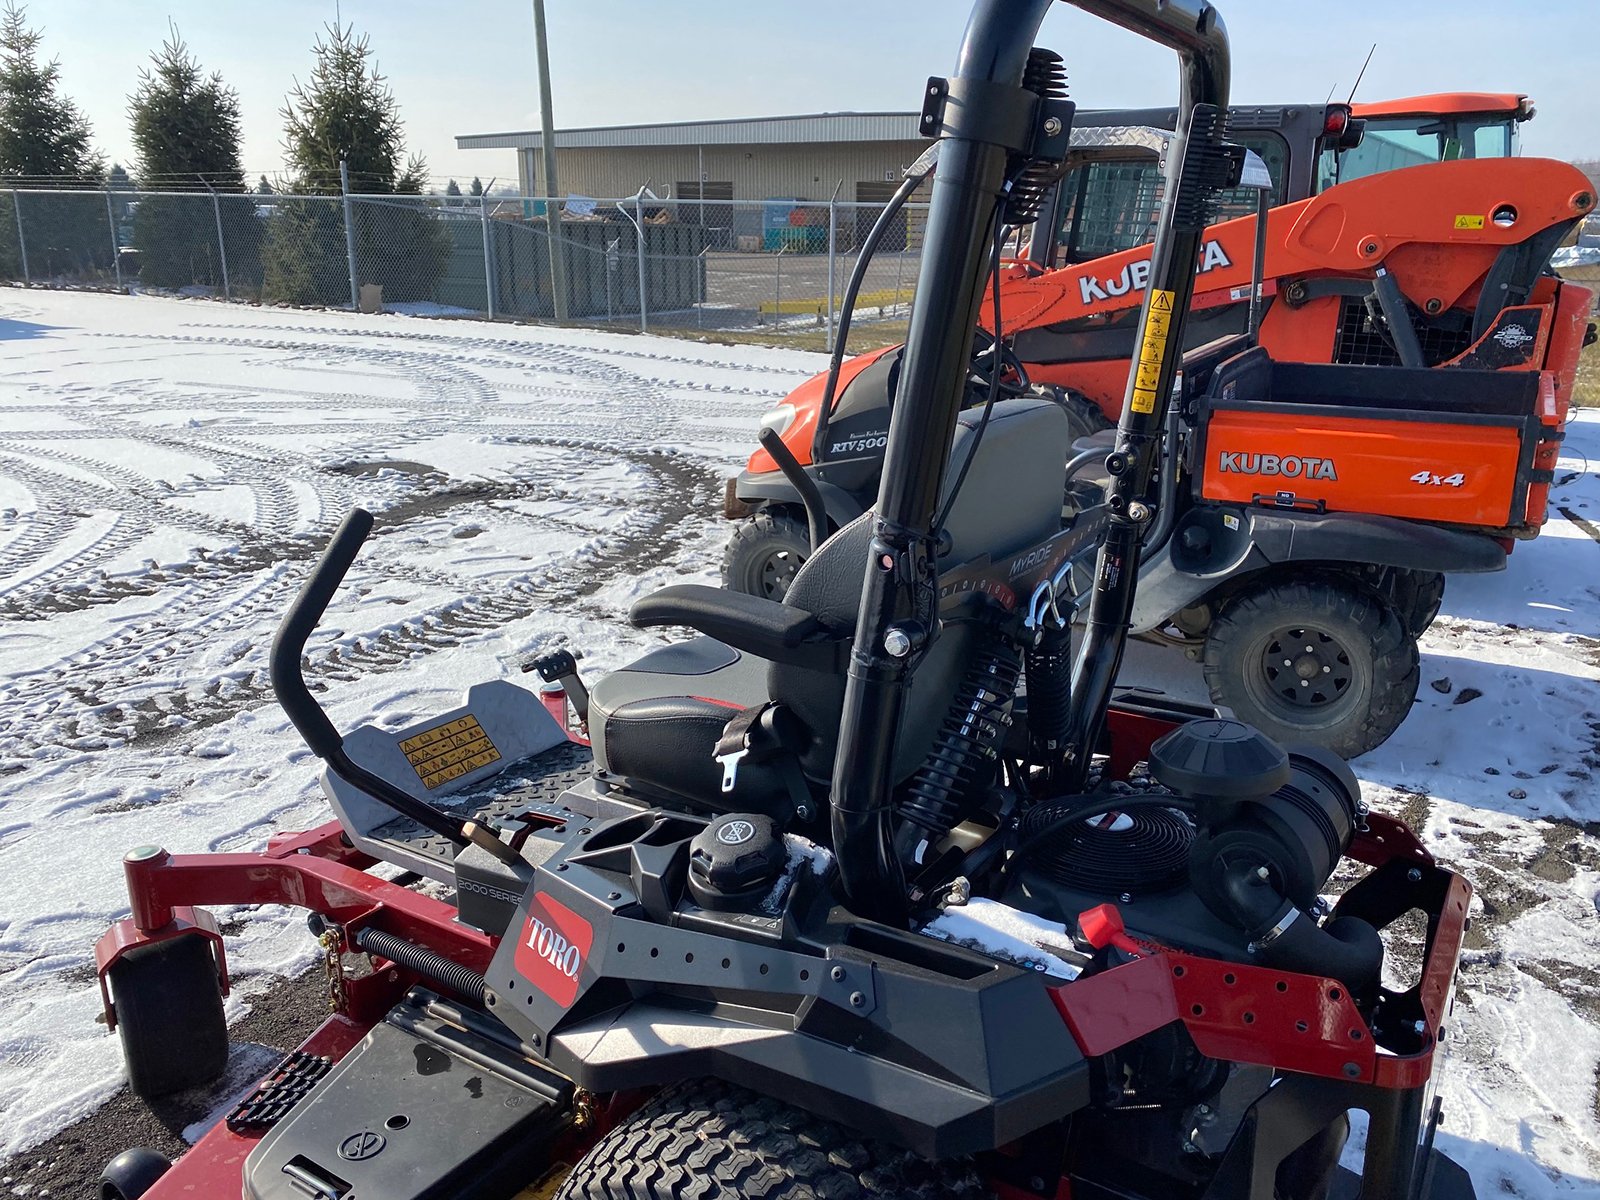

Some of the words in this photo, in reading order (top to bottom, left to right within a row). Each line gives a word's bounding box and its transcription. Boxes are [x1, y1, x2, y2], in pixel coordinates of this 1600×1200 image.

[886, 171, 894, 180] 13
[1078, 240, 1232, 304] KUBA
[830, 436, 888, 453] RTV500
[1219, 451, 1338, 481] KUBOTA
[1410, 470, 1465, 487] 4x4
[458, 880, 488, 896] 2000
[489, 888, 524, 905] SERIES
[526, 916, 580, 977] TORO
